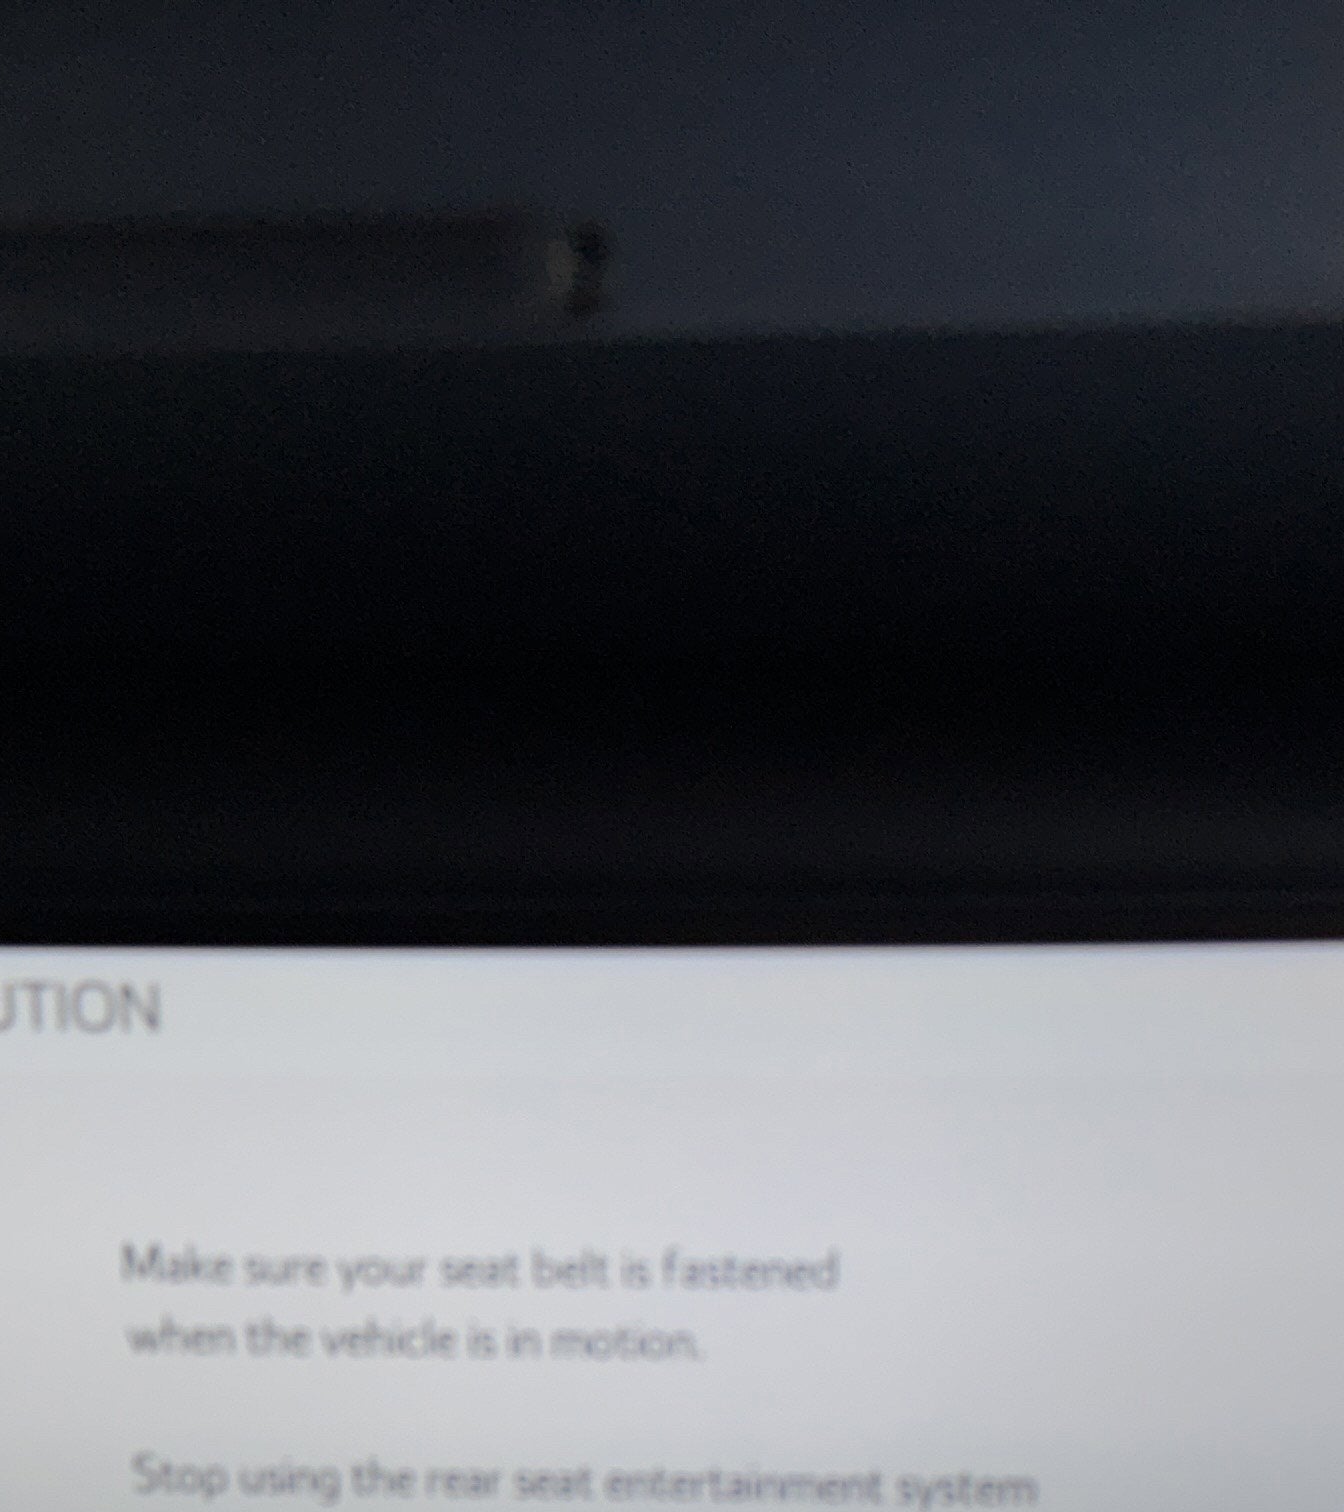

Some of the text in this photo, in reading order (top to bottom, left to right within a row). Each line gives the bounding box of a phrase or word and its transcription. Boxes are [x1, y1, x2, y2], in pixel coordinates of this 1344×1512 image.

[120, 1242, 841, 1294] Make sure your seat belt is fastened
[124, 1313, 706, 1364] when the vehicle is in motion.
[129, 1449, 231, 1503] Stop
[237, 1454, 343, 1507] using
[350, 1454, 417, 1499] the
[424, 1465, 501, 1499] rear
[511, 1464, 592, 1501] seat
[603, 1465, 882, 1506] entertainment
